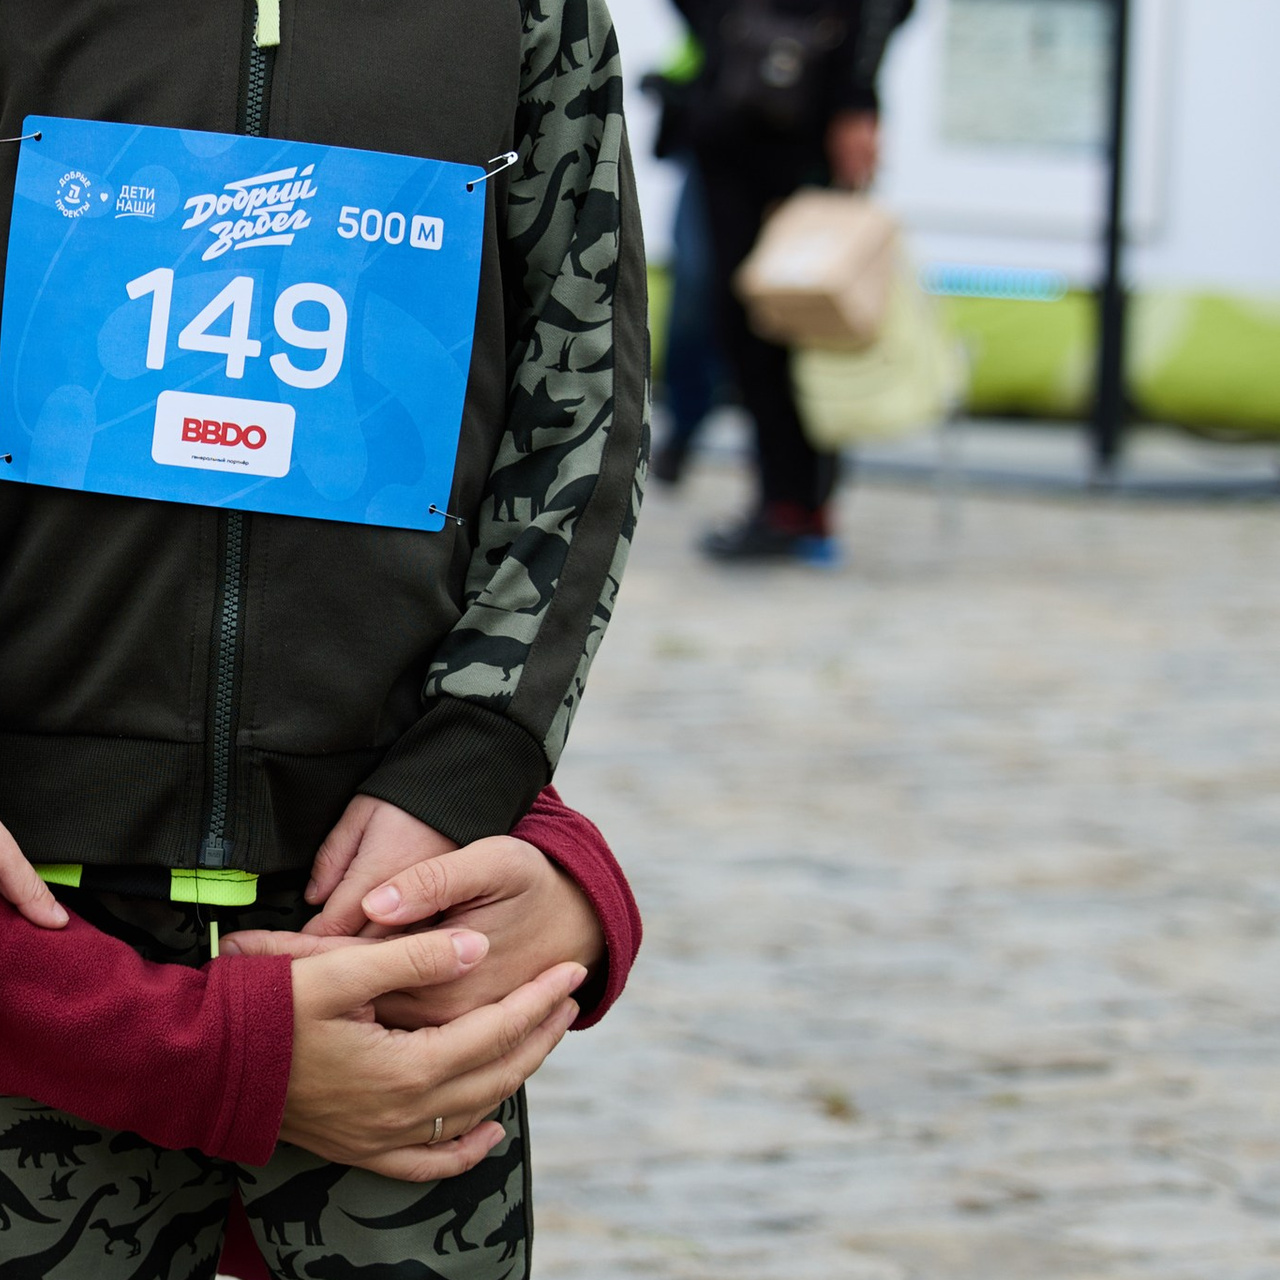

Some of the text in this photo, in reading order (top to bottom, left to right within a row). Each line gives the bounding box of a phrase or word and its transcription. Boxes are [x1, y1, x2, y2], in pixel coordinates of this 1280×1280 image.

[59, 170, 92, 188] ДОБРЫЕ
[119, 184, 155, 200] ДЕТИ
[55, 198, 91, 219] ПРОЕКТЫ
[115, 199, 156, 215] НАШИ
[336, 205, 406, 245] 500
[125, 267, 349, 390] 149
[181, 416, 268, 450] BBDO
